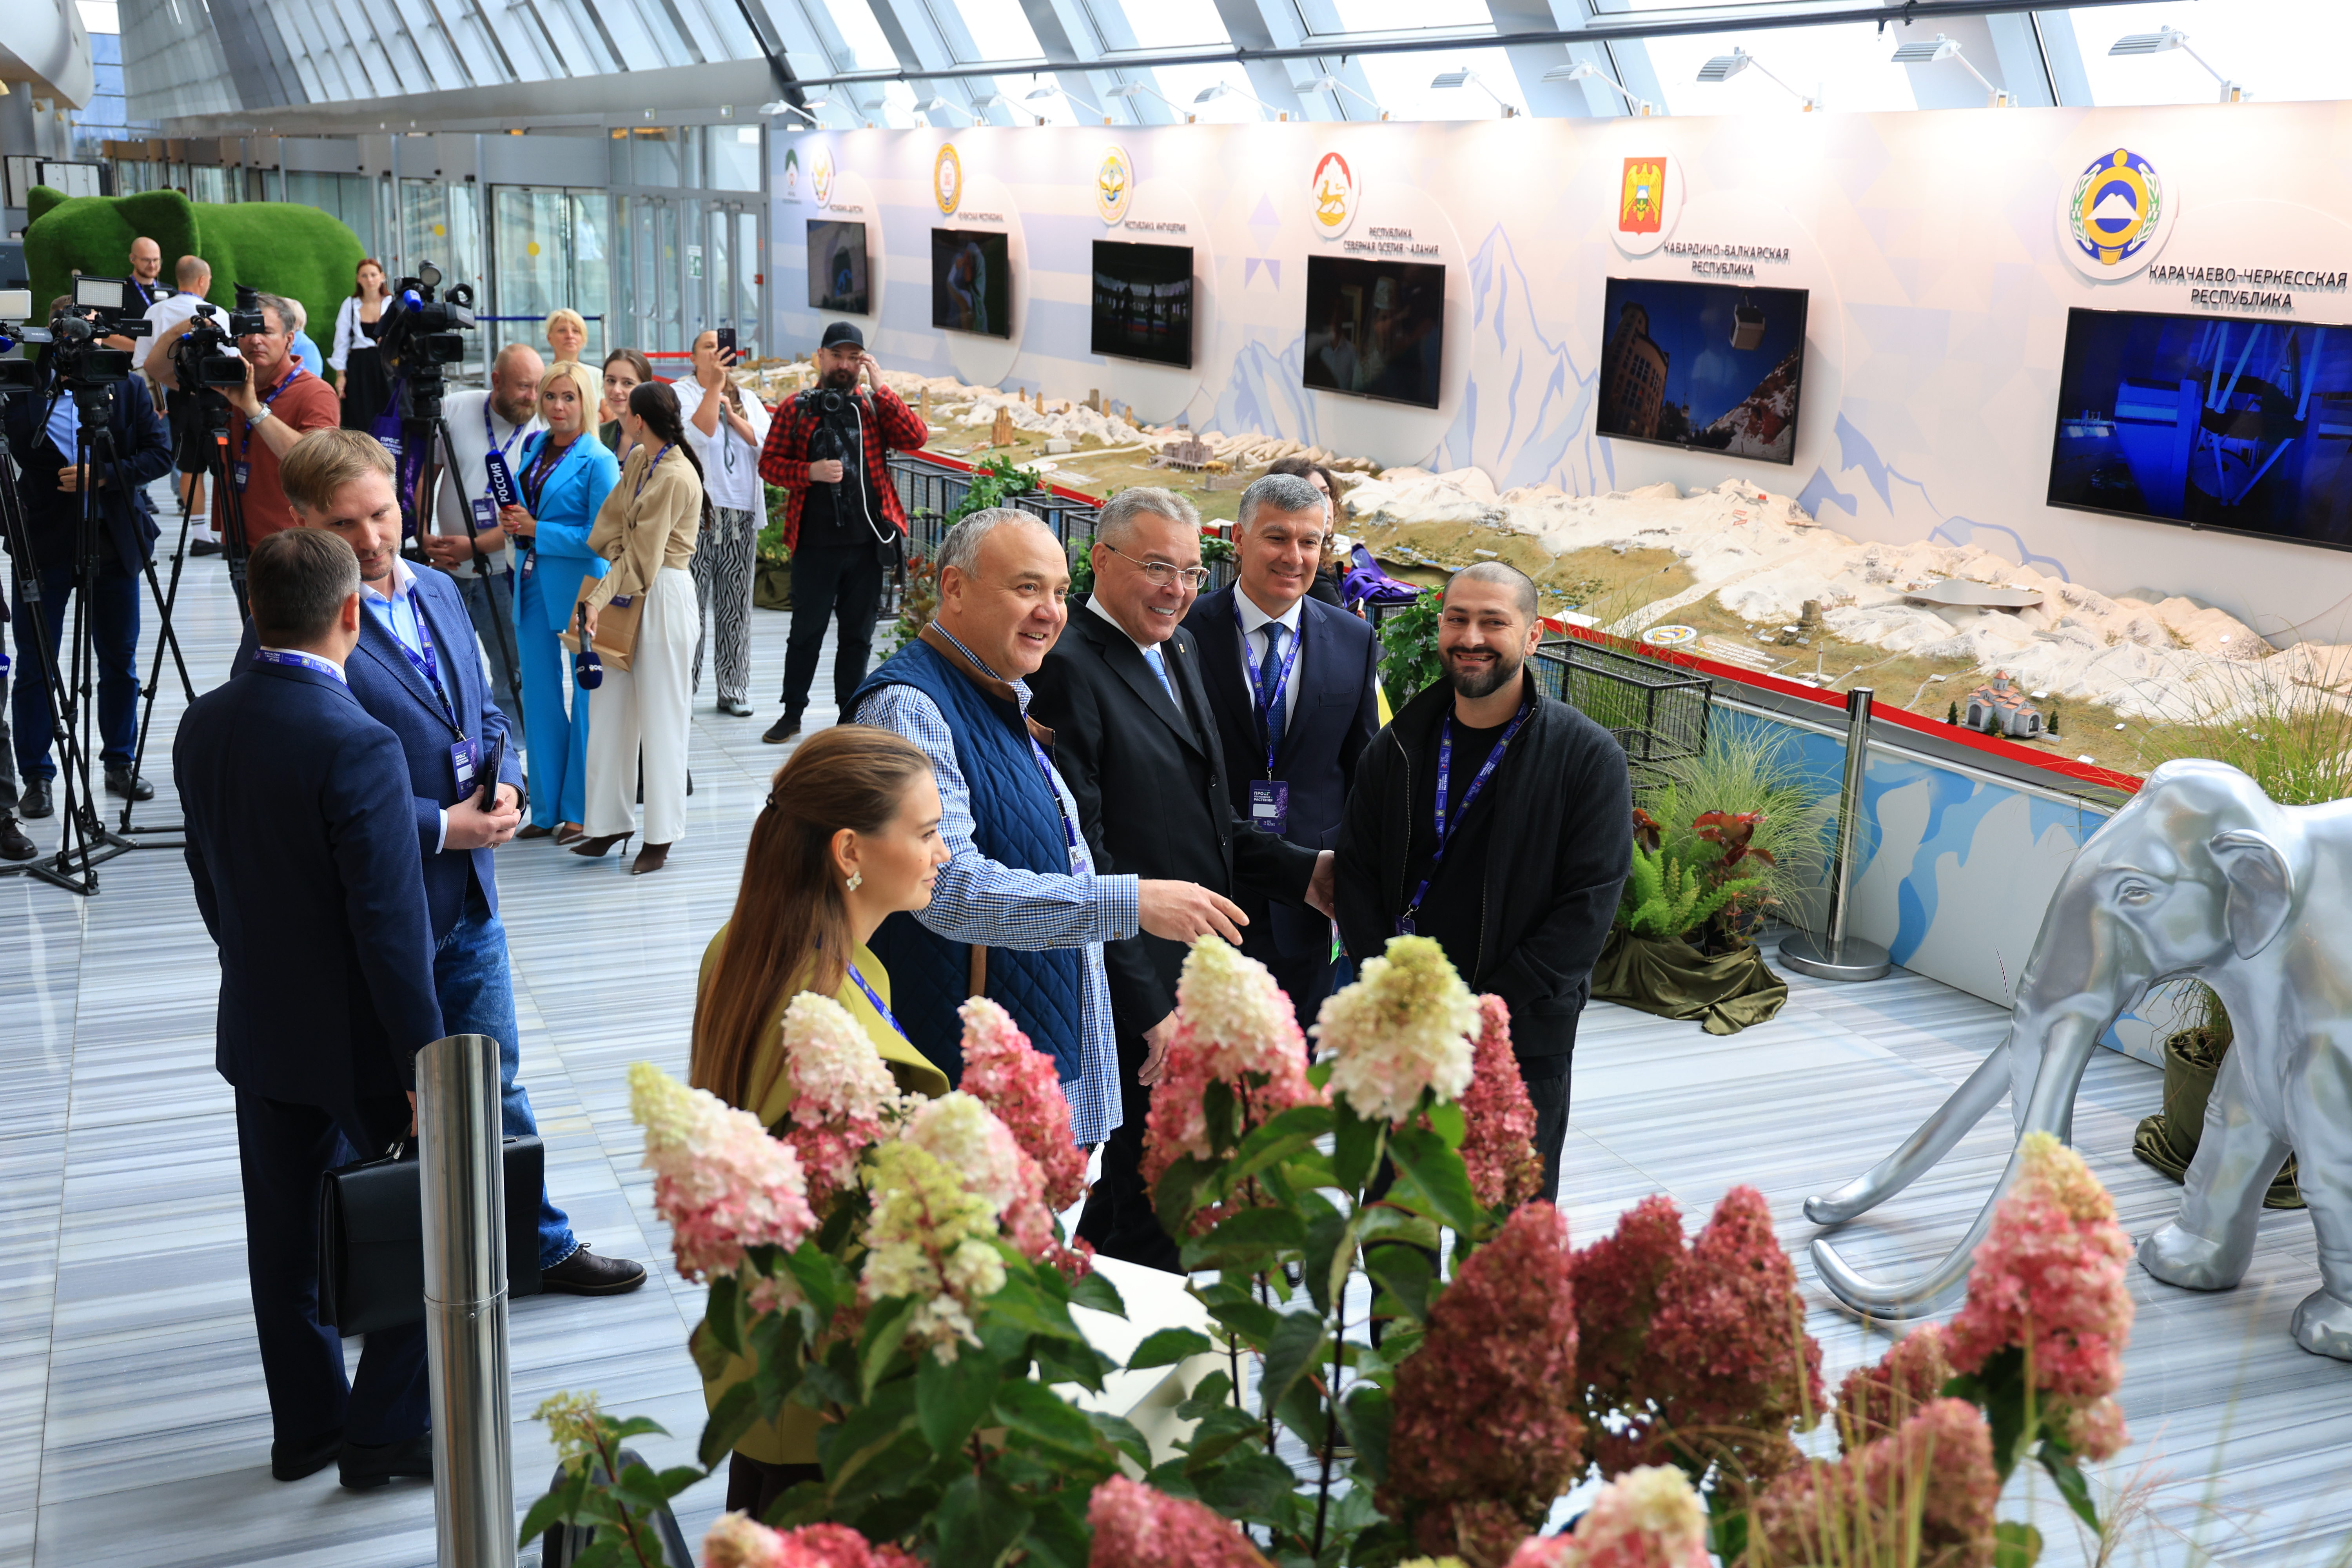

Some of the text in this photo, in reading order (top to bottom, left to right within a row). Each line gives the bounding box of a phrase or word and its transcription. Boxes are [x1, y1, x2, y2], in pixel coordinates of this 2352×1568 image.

[1369, 227, 1412, 238] РЕСПУБЛИКА
[1343, 240, 1375, 250] СЕВЕРНАЯ
[1378, 241, 1403, 252] ОСЕТИЯ
[1410, 243, 1439, 255] АЛАНИЯ
[1663, 241, 1789, 260] КАБАРДИНО-БАЛКАРСКАЯ
[1691, 260, 1754, 276] РЕСПУБЛИКА
[2149, 265, 2348, 287] КАРАЧАЕВО-ЧЕРКЕССКАЯ
[2190, 288, 2294, 308] РЕСПУБЛИКА
[490, 462, 510, 503] РОССИЯ
